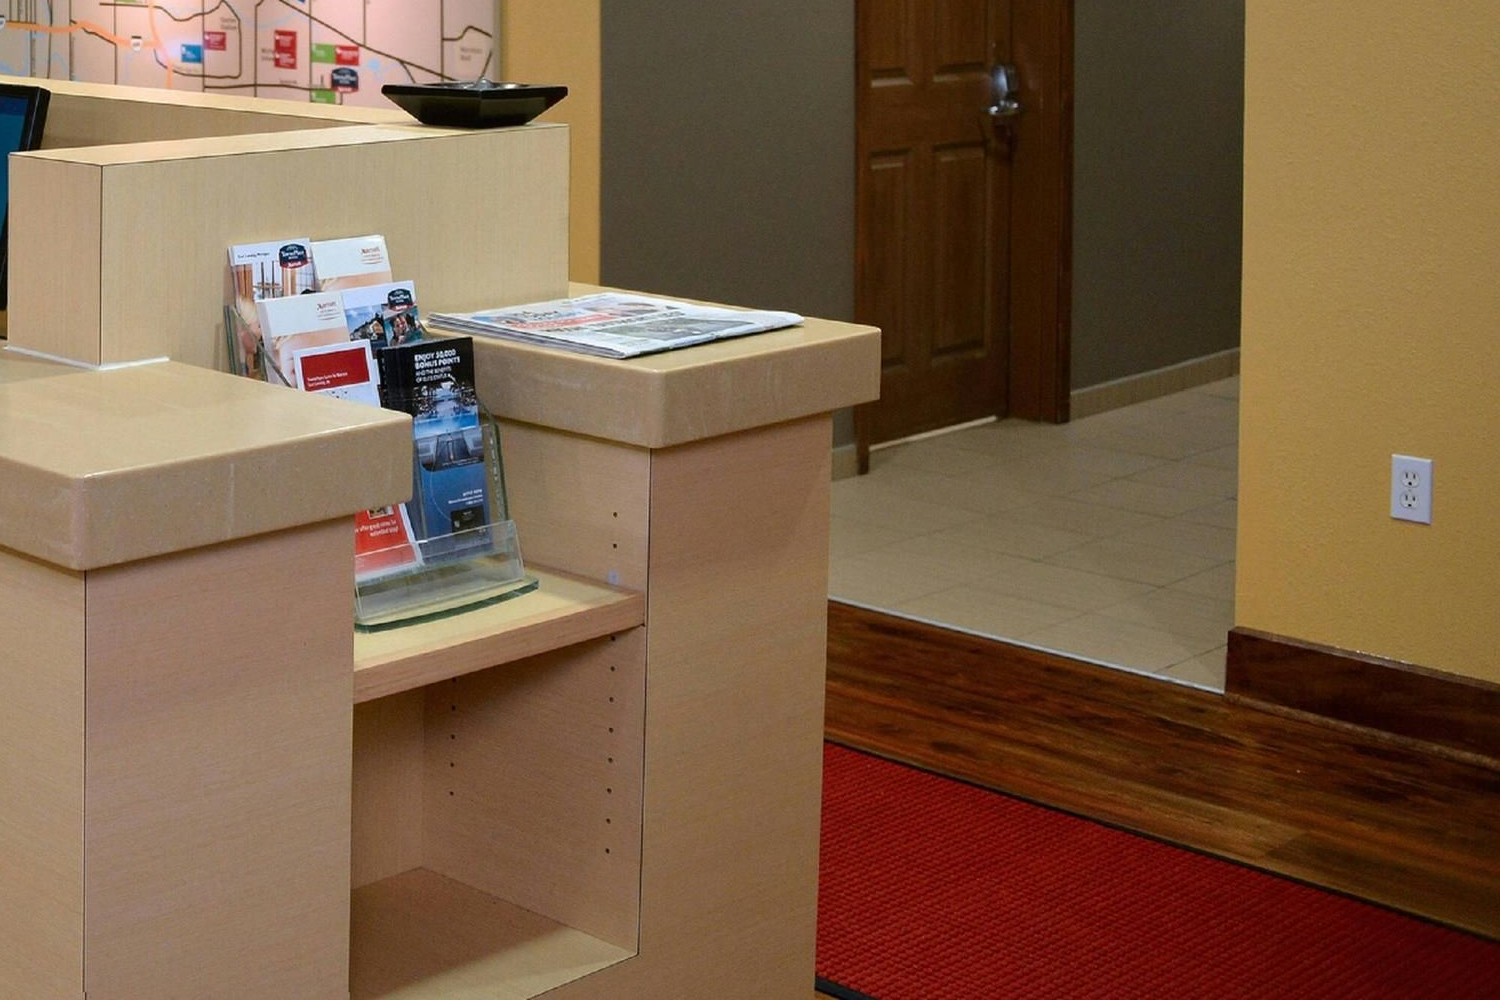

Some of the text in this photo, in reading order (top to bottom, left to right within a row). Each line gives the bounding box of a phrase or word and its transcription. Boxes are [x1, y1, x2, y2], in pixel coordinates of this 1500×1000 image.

[415, 353, 435, 362] ENJOY
[415, 356, 460, 370] BONUS POINTS
